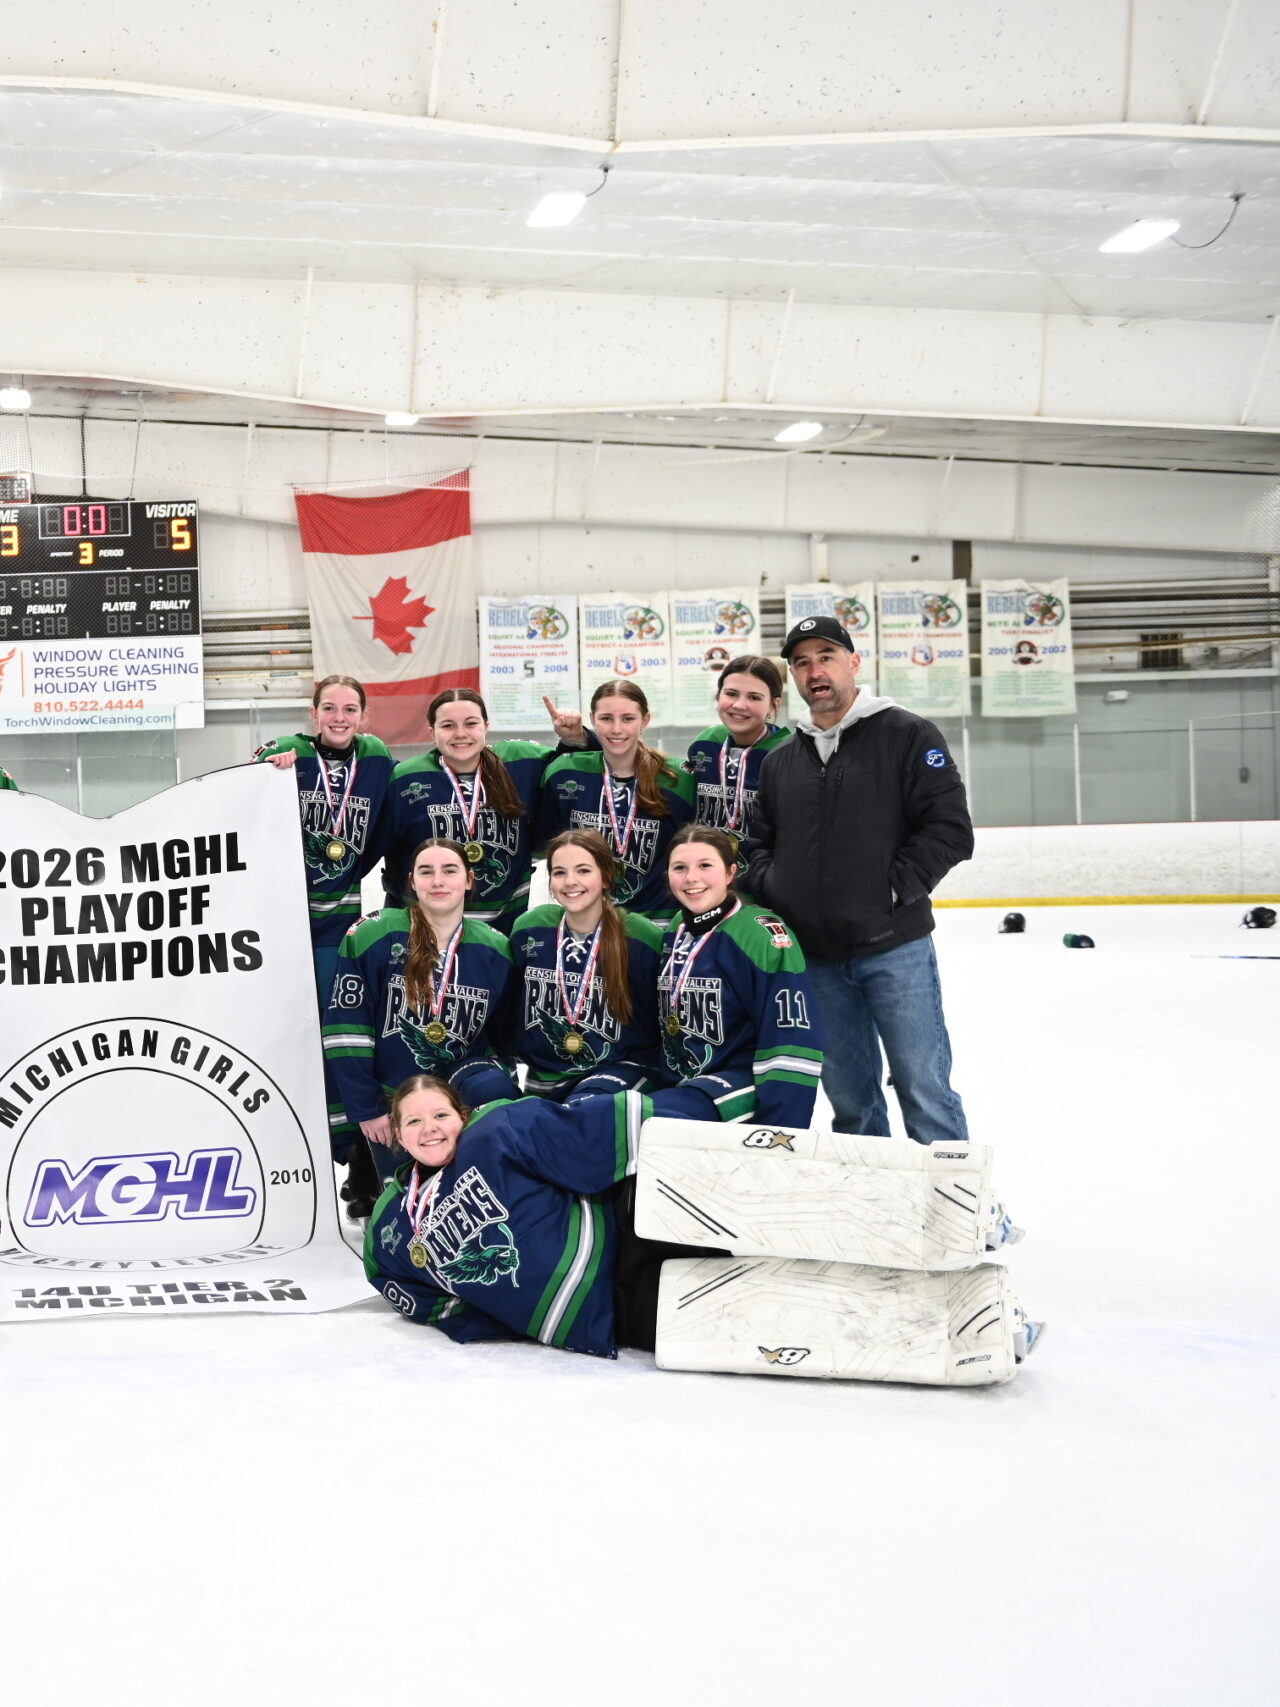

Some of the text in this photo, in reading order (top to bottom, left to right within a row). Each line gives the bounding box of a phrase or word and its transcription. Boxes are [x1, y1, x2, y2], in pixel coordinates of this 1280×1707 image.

[145, 503, 196, 518] VISITOR
[0, 525, 19, 556] 3
[171, 519, 191, 550] 5
[79, 542, 94, 564] 3
[98, 549, 124, 558] PERIOD
[26, 604, 67, 615] PENALTY
[102, 600, 190, 612] PLAYER PENALTY
[791, 599, 834, 618] REBELS
[882, 598, 924, 615] REBELS
[987, 596, 1025, 614] REBELS
[488, 608, 529, 628] REBELS
[585, 610, 625, 628] REBELS
[675, 605, 716, 624] REBELS
[33, 647, 184, 662] WINDOW CLEANING
[938, 650, 963, 658] 2002
[1041, 645, 1066, 654] 2002
[34, 662, 199, 678] PRESSURE WASHING
[490, 666, 514, 674] 2003
[544, 664, 568, 672] 2004
[586, 660, 612, 668] 2002
[641, 658, 666, 666] 2003
[34, 680, 157, 694] HOLIDAY LIGHTS
[34, 699, 144, 712] 810.522.4444
[4, 715, 171, 728] TorchWindowCleaning.com
[120, 832, 247, 884] MGHL
[20, 884, 210, 936] PLAYOFF
[694, 908, 722, 924] CCM
[775, 989, 810, 1029] 11
[170, 1036, 270, 1114] GIRLS
[270, 1168, 312, 1186] 2010
[23, 1147, 257, 1228] MGHL
[126, 1280, 245, 1296] TIER
[14, 1287, 308, 1310] MICHIGAN
